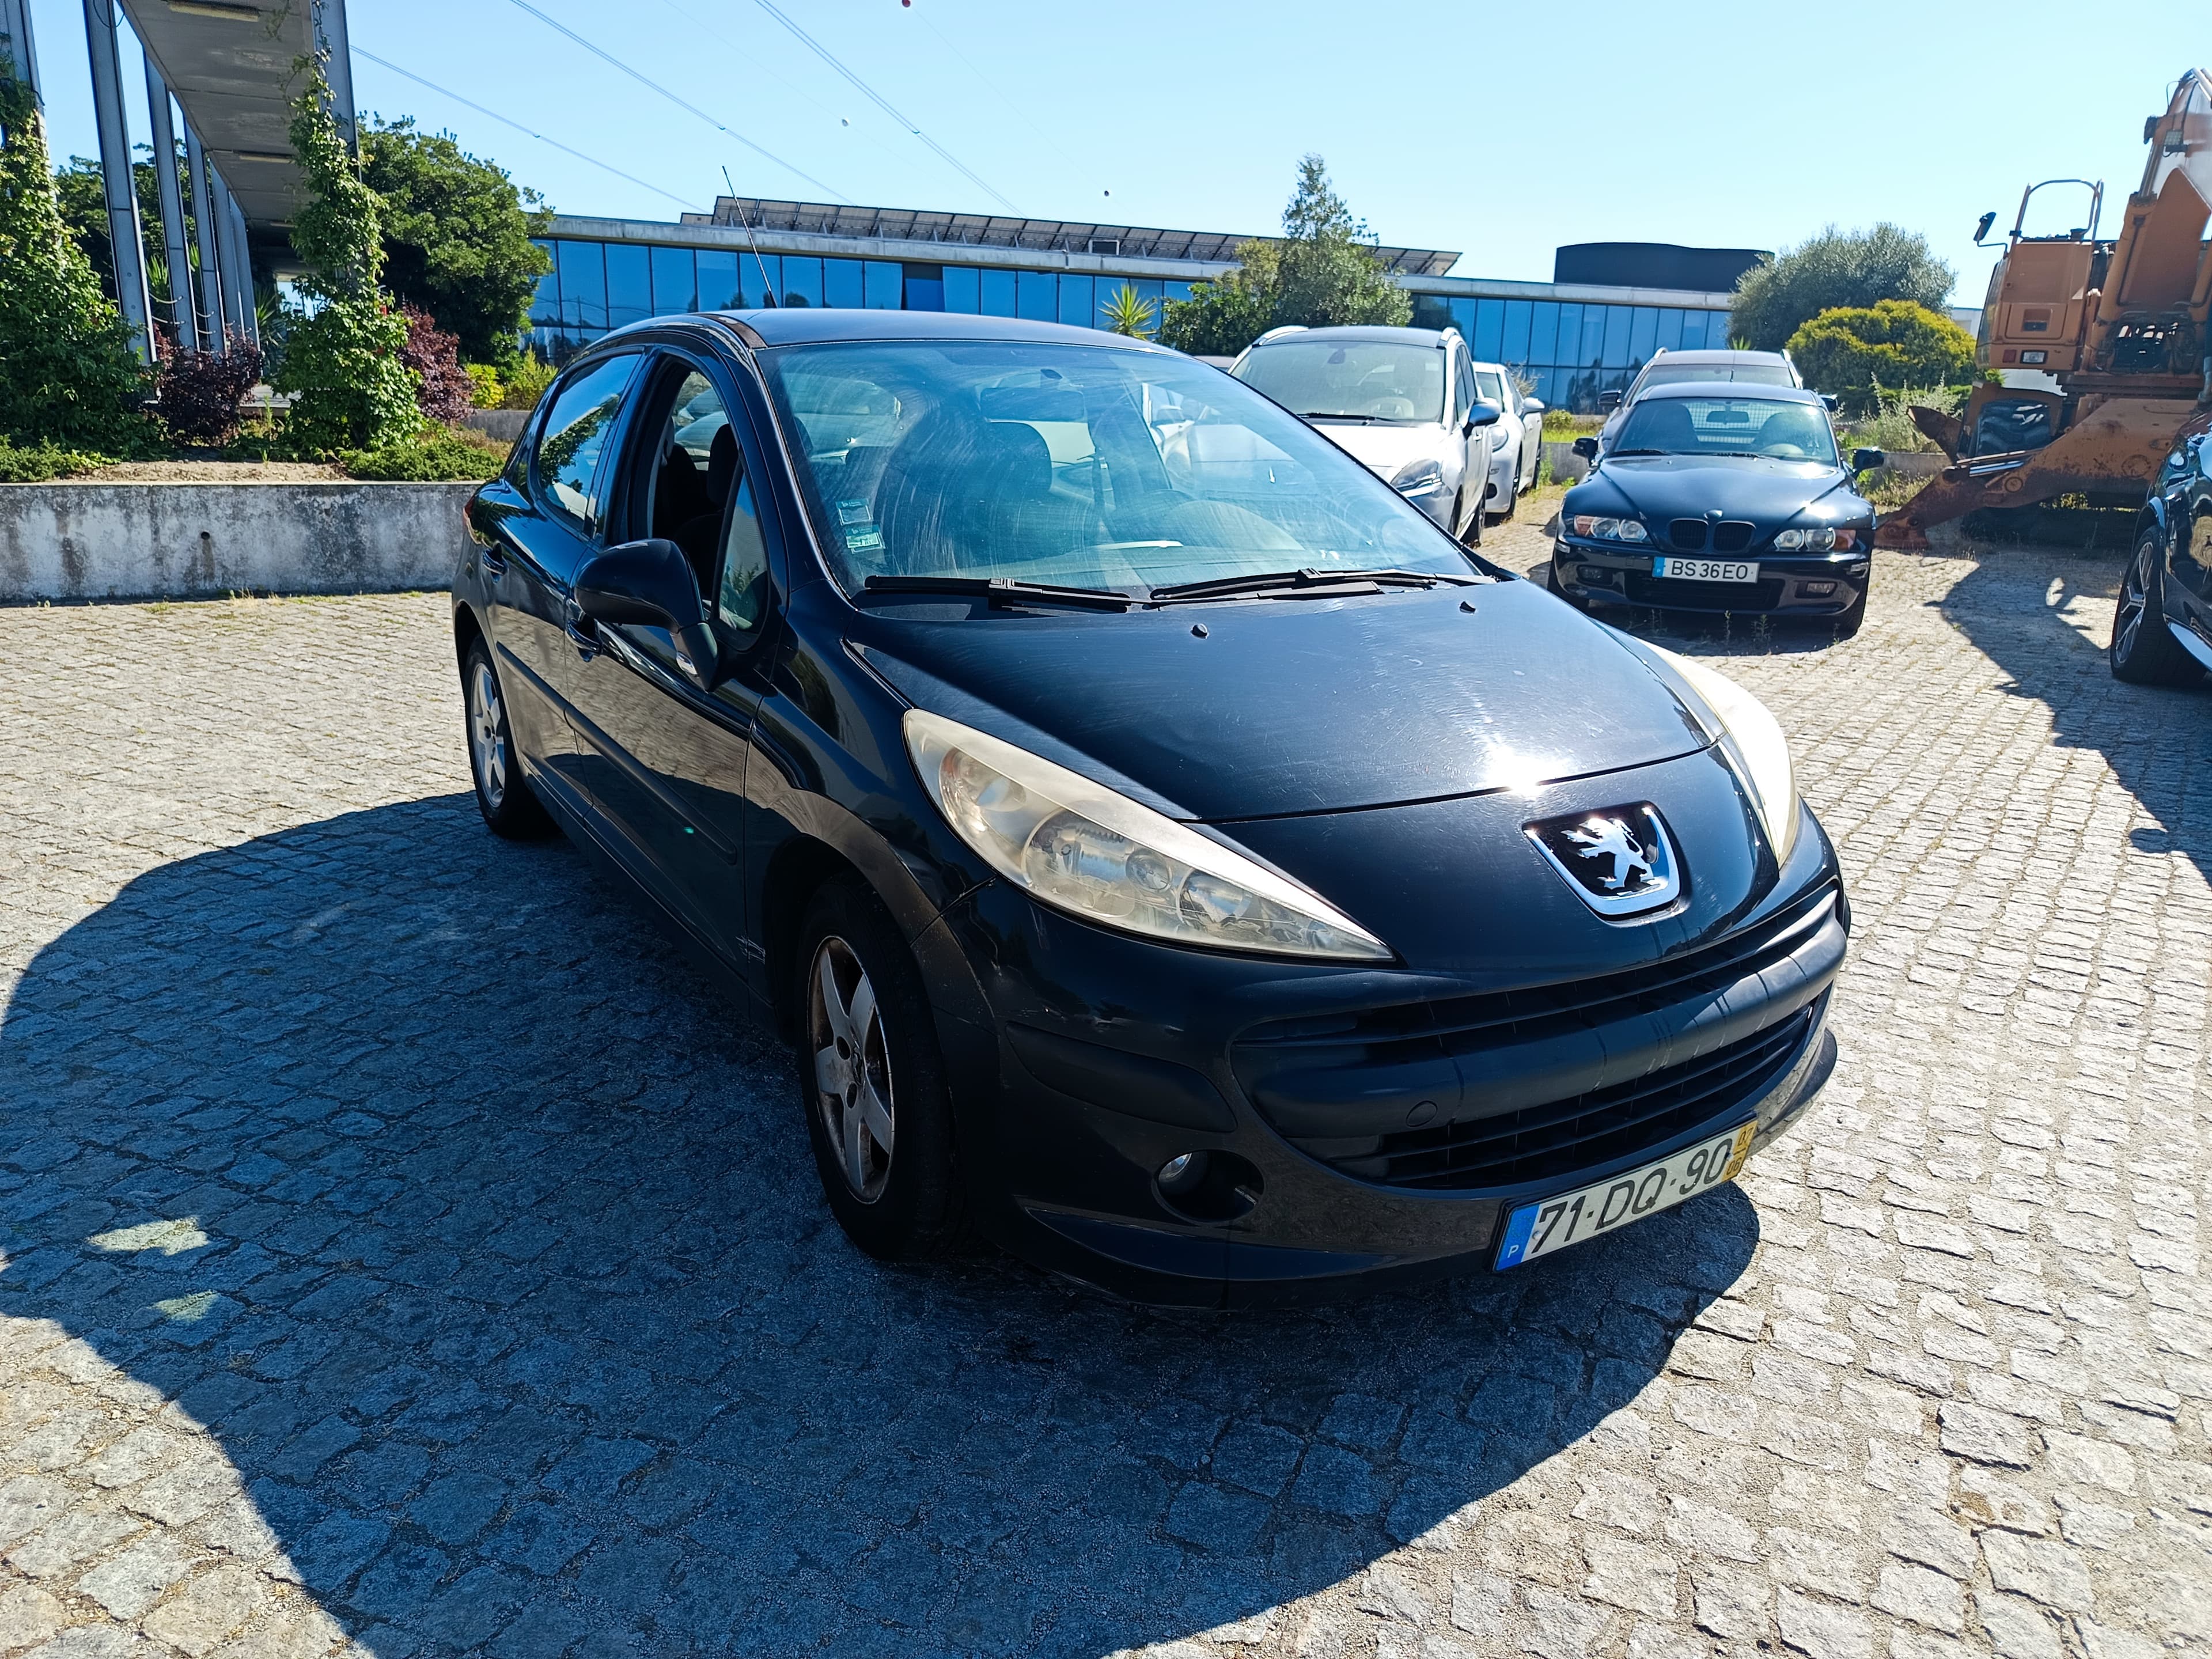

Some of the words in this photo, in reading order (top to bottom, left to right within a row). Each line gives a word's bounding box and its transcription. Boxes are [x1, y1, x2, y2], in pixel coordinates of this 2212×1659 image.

[1737, 1127, 1754, 1146] 07
[1726, 1157, 1742, 1175] 06
[1508, 1244, 1520, 1259] P
